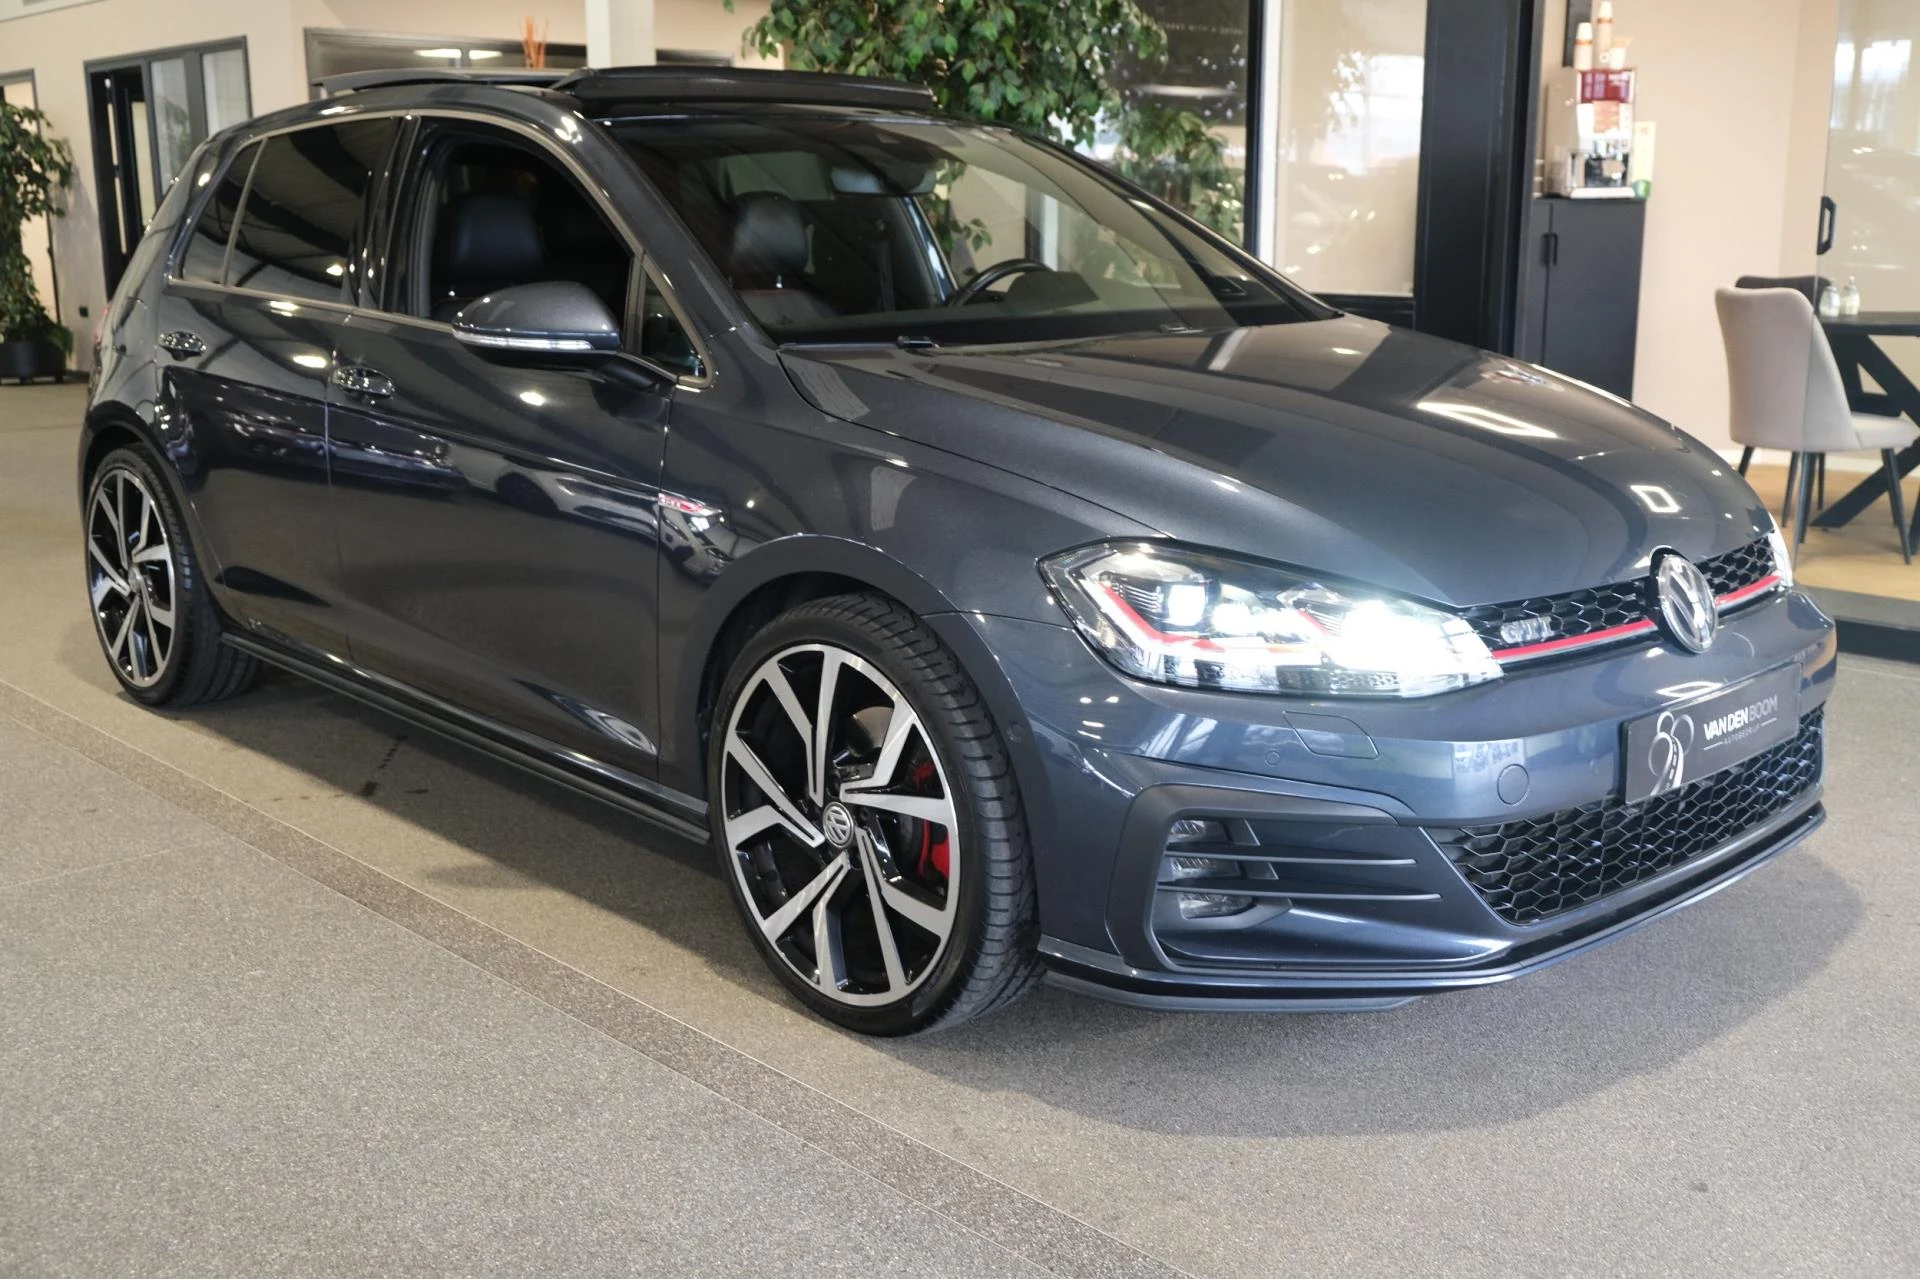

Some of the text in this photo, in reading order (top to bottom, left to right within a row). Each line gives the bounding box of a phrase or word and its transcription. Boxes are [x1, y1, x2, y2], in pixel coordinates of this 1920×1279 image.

[1500, 616, 1555, 644] GTI
[1703, 716, 1727, 741] VAN
[1727, 707, 1749, 732] DEN
[1749, 694, 1778, 722] BOOM
